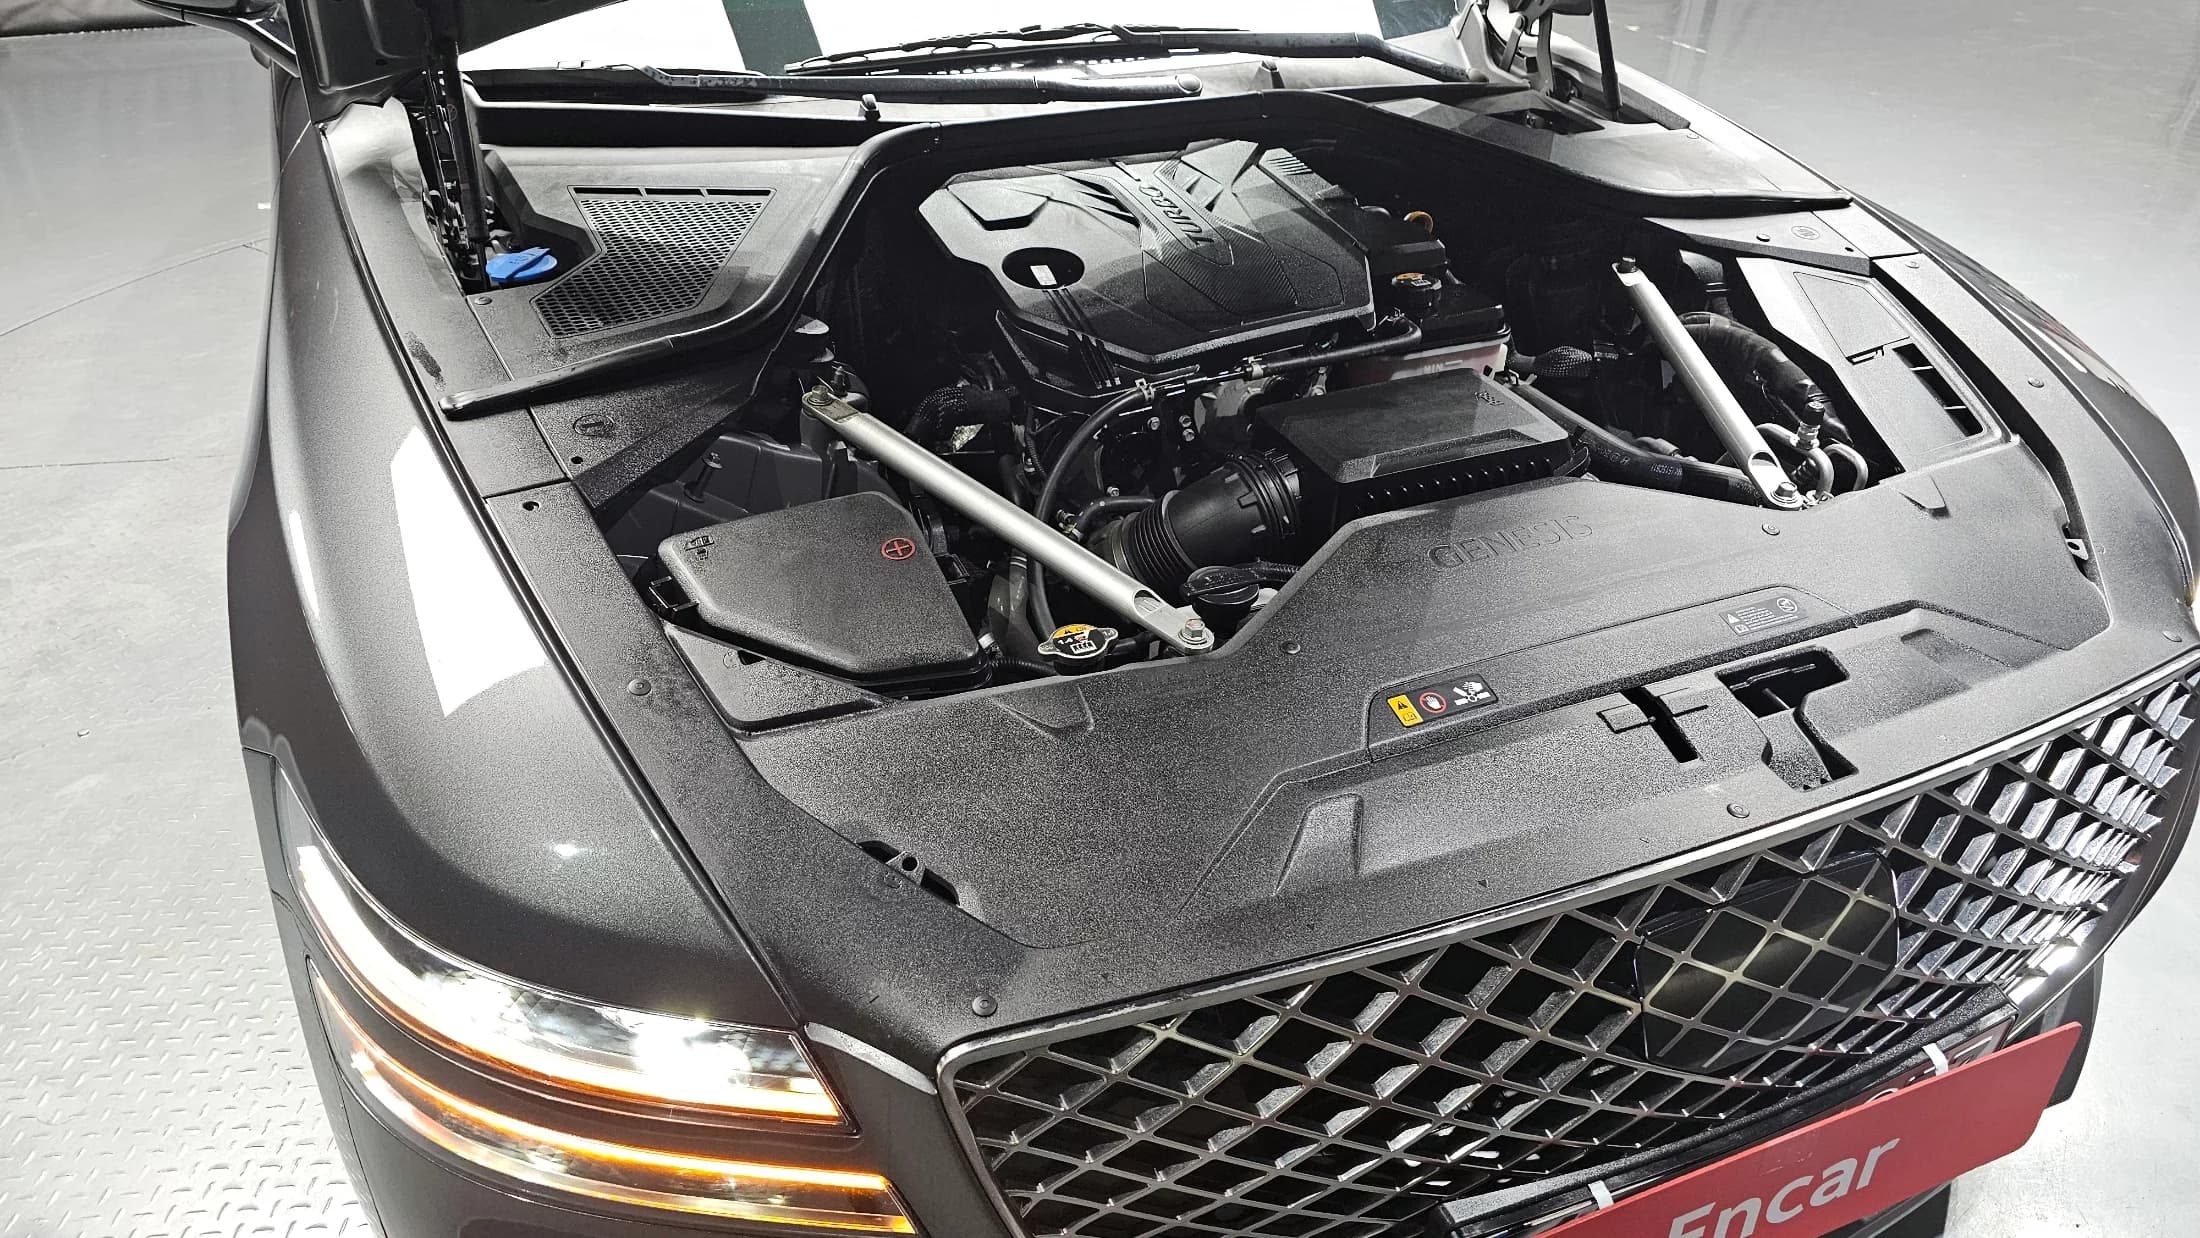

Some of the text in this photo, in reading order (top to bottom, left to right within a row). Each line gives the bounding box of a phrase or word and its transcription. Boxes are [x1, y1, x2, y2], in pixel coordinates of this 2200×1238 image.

[1138, 181, 1215, 248] TURBO
[1427, 515, 1593, 569] GENESIS
[1668, 1137, 1900, 1238] Encar
